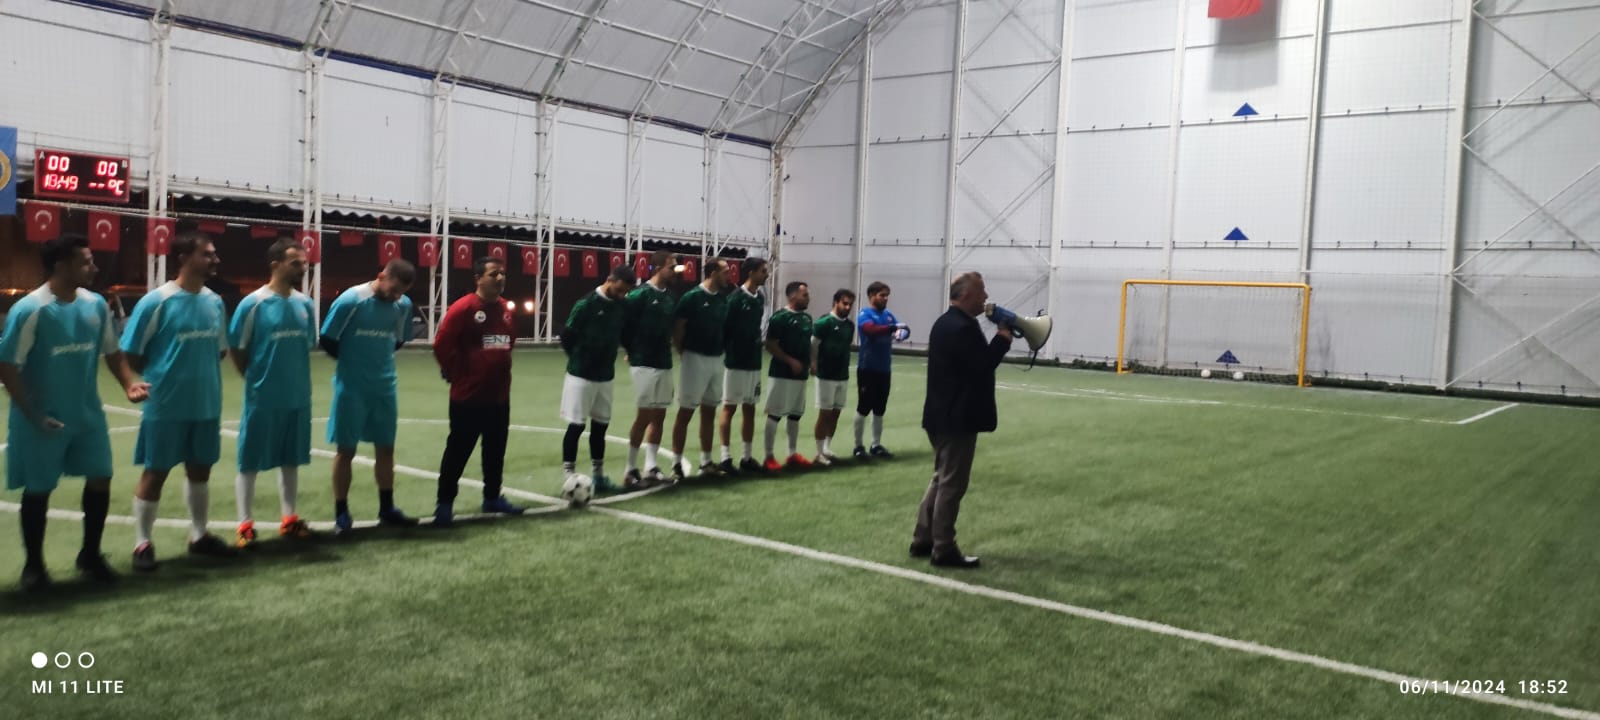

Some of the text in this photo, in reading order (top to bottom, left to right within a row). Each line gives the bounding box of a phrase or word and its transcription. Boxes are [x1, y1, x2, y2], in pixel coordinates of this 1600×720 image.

[39, 150, 45, 160] A
[48, 155, 70, 172] 00
[97, 160, 118, 177] 00
